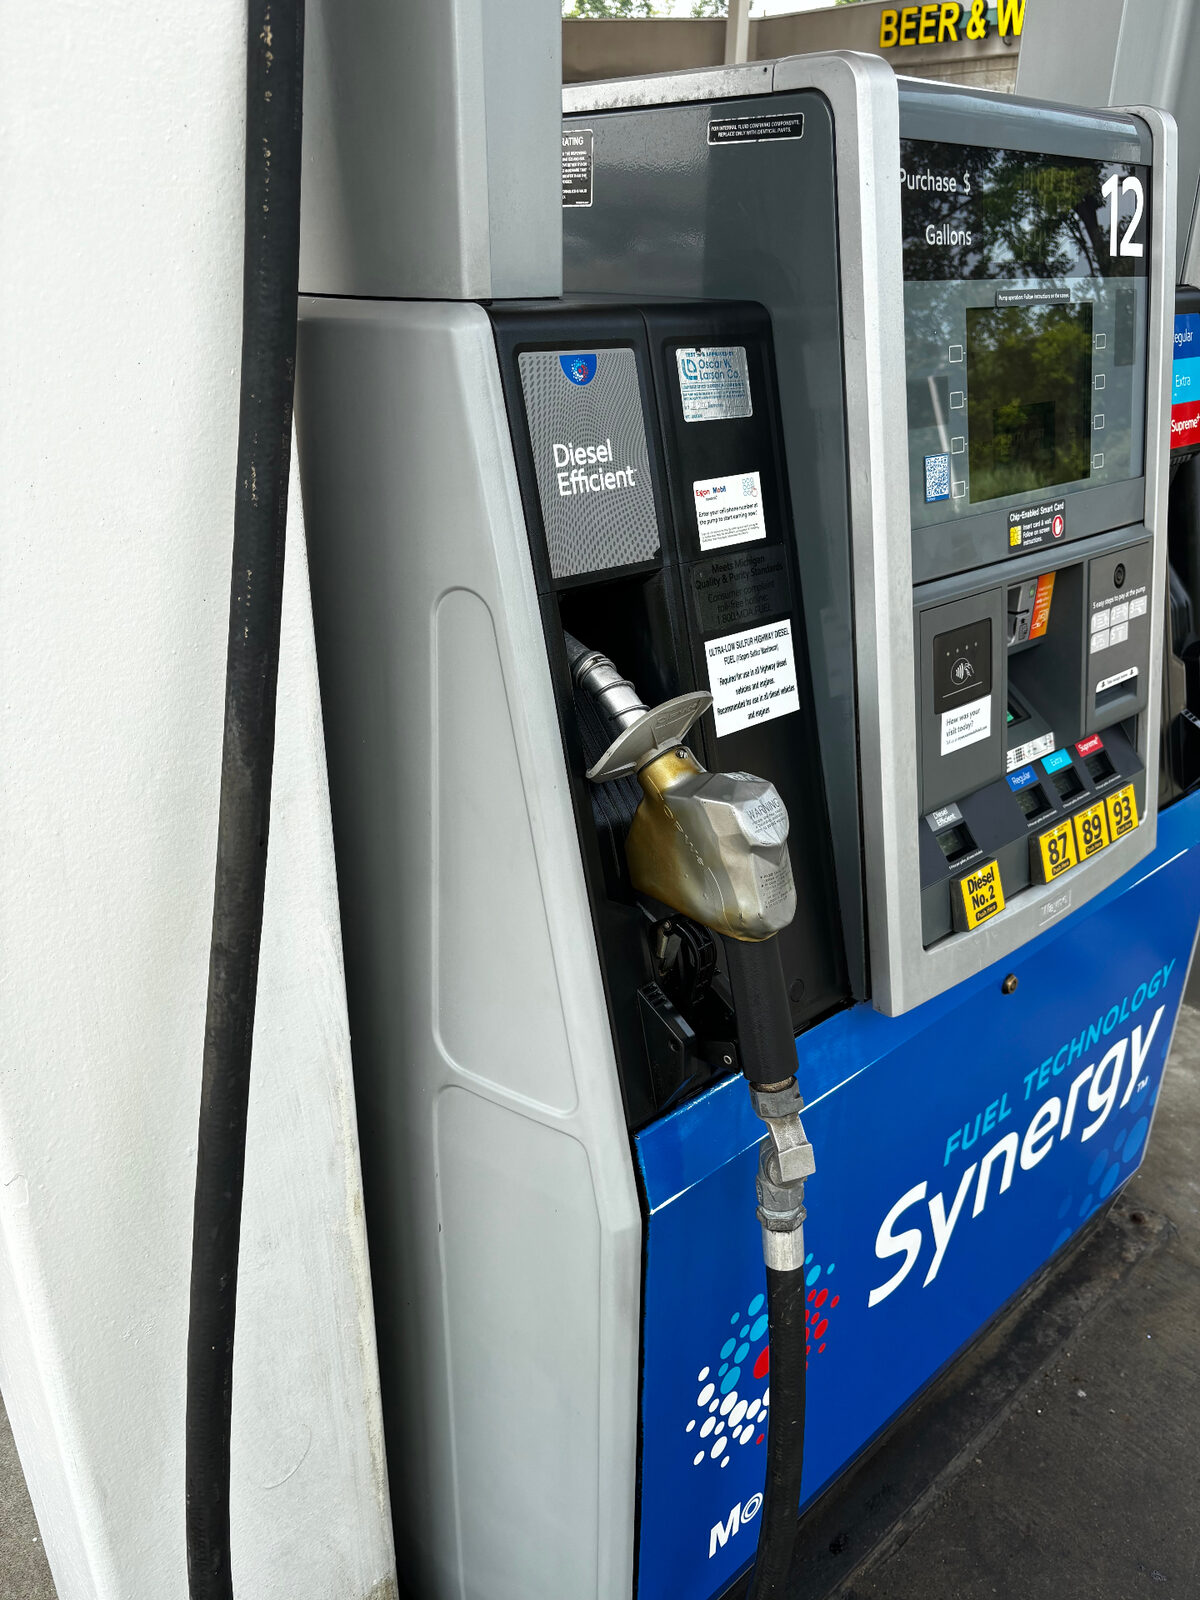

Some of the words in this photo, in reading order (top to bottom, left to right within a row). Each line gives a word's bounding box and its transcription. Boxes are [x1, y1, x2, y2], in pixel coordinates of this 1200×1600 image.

[880, 1, 960, 48] BEER
[966, 0, 987, 40] &
[997, 0, 1026, 37] W
[718, 130, 735, 138] REPLACE
[900, 167, 957, 193] Purchase
[962, 170, 972, 195] $
[1101, 173, 1144, 257] 12
[925, 223, 972, 246] Gallons
[1173, 329, 1193, 346] egular
[698, 359, 722, 369] Oscar
[699, 370, 725, 380] Larson
[1175, 374, 1191, 388] Extra
[552, 438, 613, 468] Diesel
[557, 465, 636, 497] Efficient
[695, 489, 711, 498] Exxon
[712, 485, 727, 494] Mobil
[726, 505, 738, 513] phone
[738, 503, 753, 511] number
[1010, 508, 1039, 522] Chip-Enabled
[1040, 504, 1053, 515] Smart
[1053, 501, 1064, 511] Card
[707, 517, 718, 526] pump
[723, 514, 732, 522] start
[732, 512, 747, 520] earning
[1022, 523, 1032, 531] Insert
[1022, 530, 1033, 538] Follow
[711, 561, 734, 574] Meets
[734, 555, 765, 568] Michigan
[694, 576, 721, 590] Quality
[721, 574, 728, 583] &
[728, 571, 749, 582] Purity
[750, 562, 784, 577] Standards
[1135, 586, 1146, 596] pump
[709, 642, 736, 657] ULTRA-LOW
[736, 637, 753, 650] SULFUR
[753, 631, 774, 645] HIGHWAY
[774, 627, 790, 639] DIESEL
[723, 655, 736, 665] FUEL
[719, 674, 736, 686] Required
[750, 668, 754, 676] in
[760, 662, 776, 674] highway
[776, 658, 788, 668] diesel
[735, 685, 752, 695] vehicles
[752, 682, 760, 691] and
[716, 701, 746, 716] Recommended
[768, 688, 780, 699] diesel
[945, 716, 958, 727] How
[959, 712, 969, 722] was
[969, 707, 981, 720] your
[945, 726, 957, 737] visit
[957, 719, 974, 732] today?
[1049, 756, 1063, 767] Extra
[1011, 771, 1031, 785] Regular
[745, 797, 780, 821] WARNING
[1113, 795, 1132, 826] 93
[1082, 814, 1102, 845] 89
[1048, 831, 1068, 865] 87
[967, 866, 995, 895] Diesel
[971, 893, 988, 910] No.
[988, 885, 995, 900] 2
[943, 1092, 1012, 1167] FUEL
[1023, 957, 1176, 1101] TECHNOLOGY
[867, 1003, 1166, 1309] Synergy
